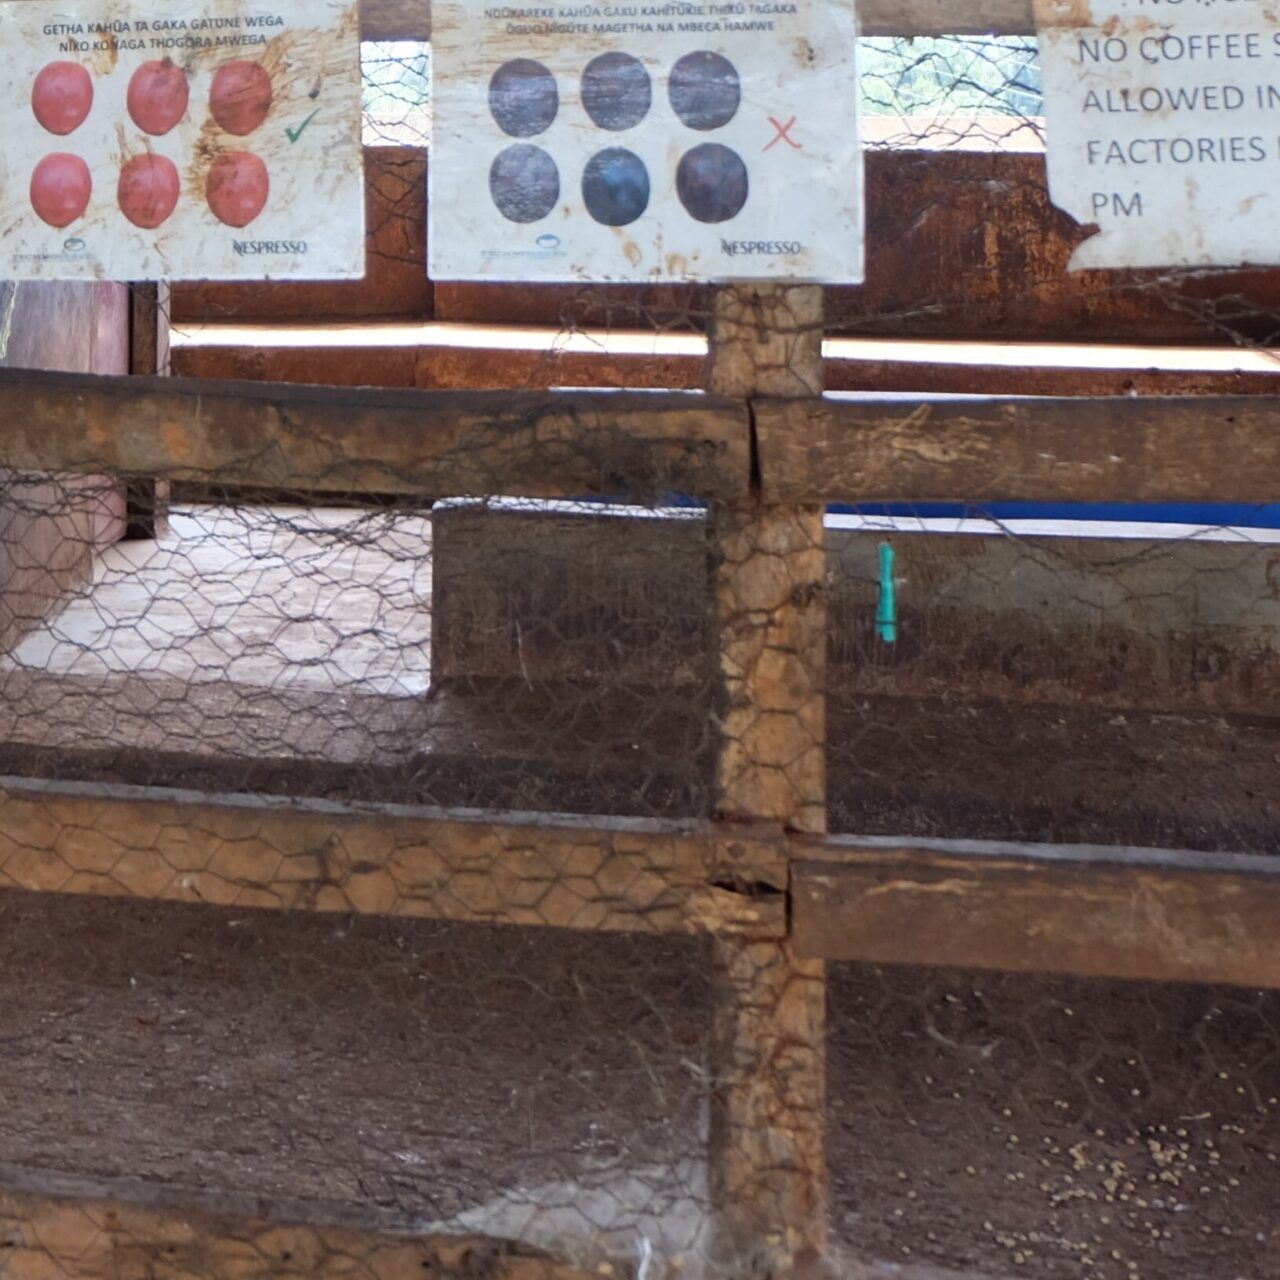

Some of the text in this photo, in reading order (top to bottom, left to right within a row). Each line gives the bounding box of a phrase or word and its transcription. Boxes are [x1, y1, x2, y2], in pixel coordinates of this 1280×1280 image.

[603, 5, 637, 17] GAKU
[43, 24, 83, 36] GETHA
[134, 21, 148, 32] TA
[152, 20, 187, 32] GAKA
[244, 15, 283, 28] WEGA
[592, 22, 653, 33] MAGETHA
[656, 21, 674, 32] NA
[678, 21, 721, 32] MBECA
[724, 20, 774, 32] HAMWE
[216, 34, 266, 47] MWEGA
[1079, 37, 1127, 62] NO
[1140, 33, 1261, 61] COFFEE
[1082, 85, 1244, 113] ALLOWED
[1087, 136, 1266, 164] FACTORIES
[1092, 192, 1142, 216] PM
[232, 238, 307, 256] NESPRESSO
[721, 238, 801, 257] NESPRESSO
